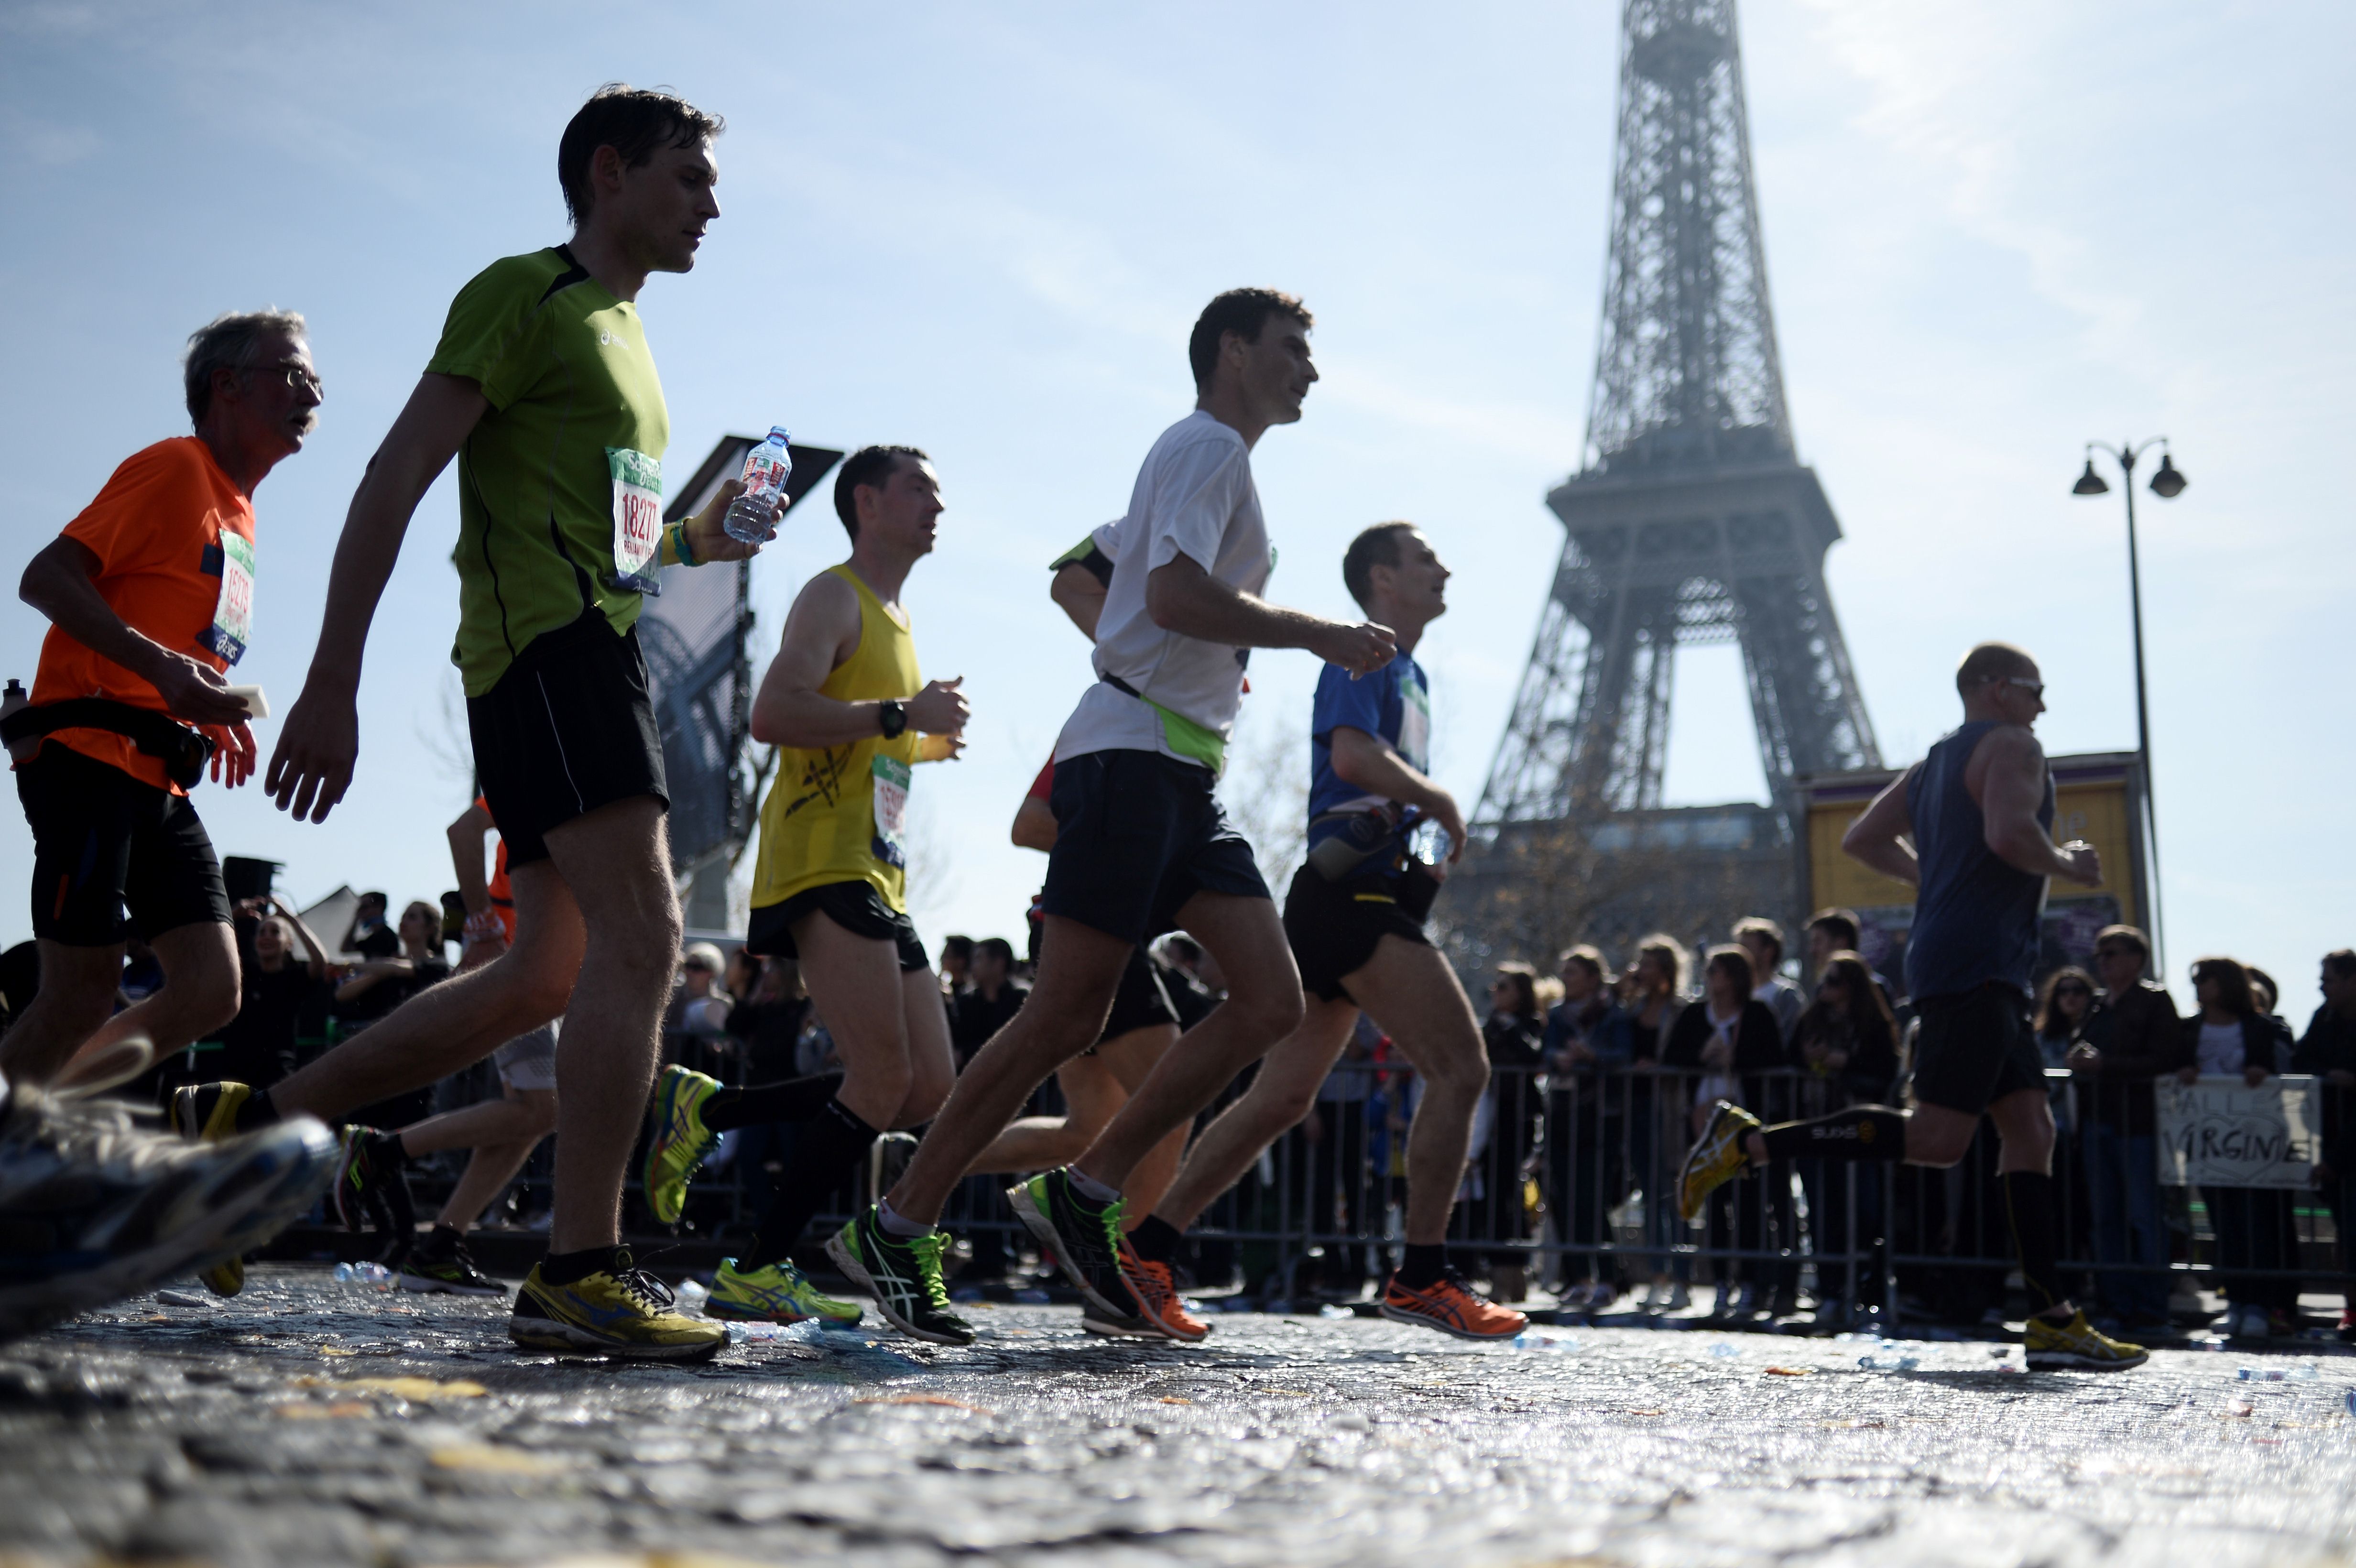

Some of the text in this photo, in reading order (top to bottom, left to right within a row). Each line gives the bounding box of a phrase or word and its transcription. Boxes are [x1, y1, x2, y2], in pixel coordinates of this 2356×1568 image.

[623, 493, 656, 543] 18277
[227, 567, 248, 614] 15279
[2163, 1123, 2310, 1164] VIRGINIE
